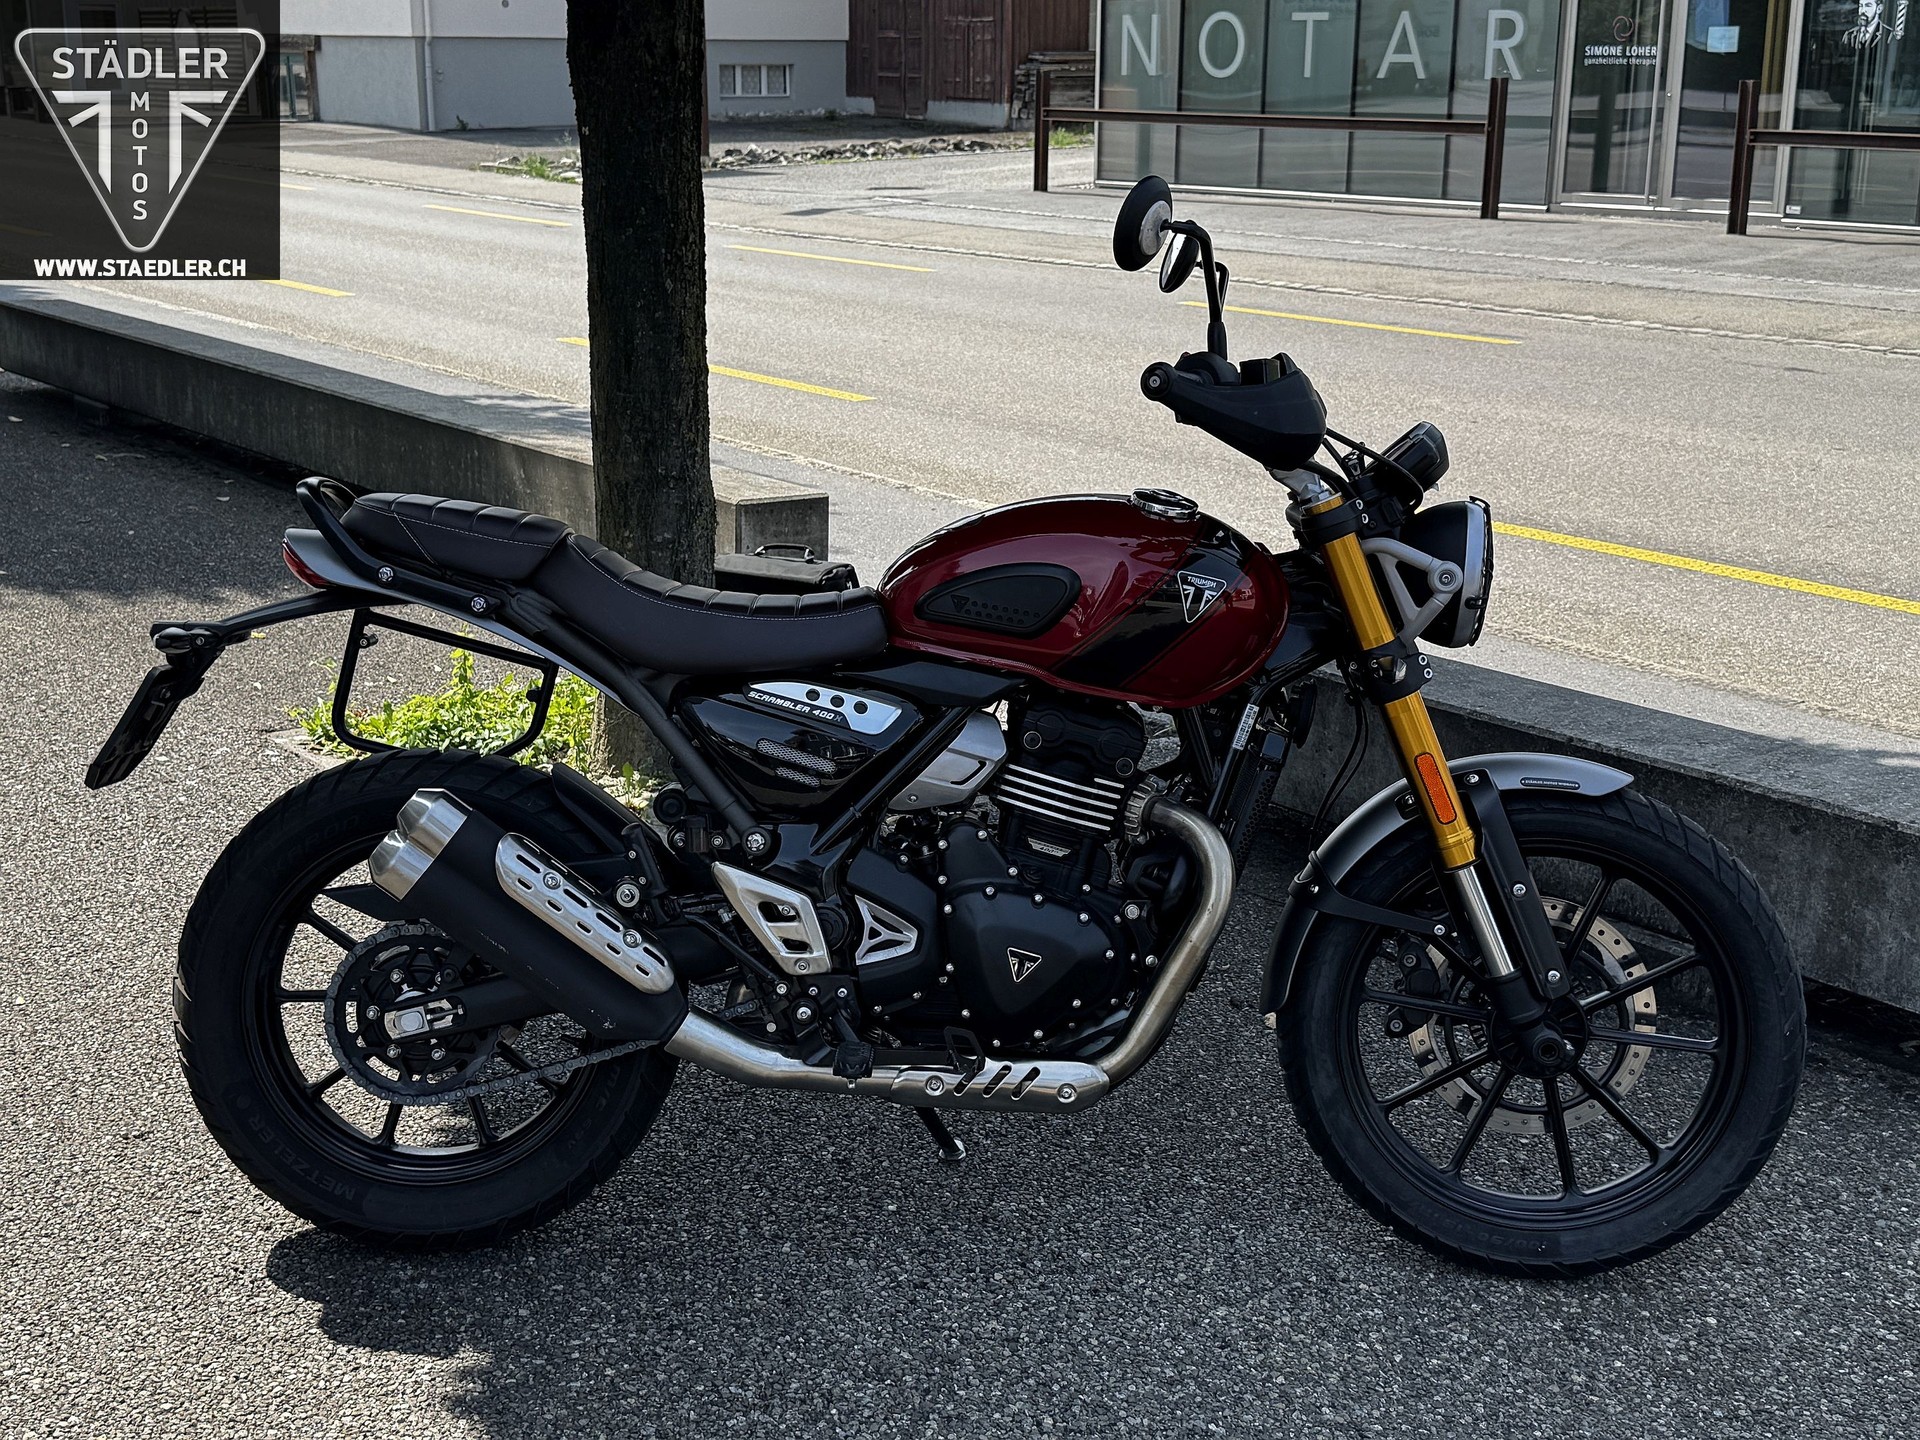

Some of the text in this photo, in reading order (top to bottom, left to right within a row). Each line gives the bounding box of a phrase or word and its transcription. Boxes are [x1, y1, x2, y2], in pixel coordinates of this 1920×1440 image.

[1121, 10, 1525, 81] NOTAR
[1584, 45, 1657, 56] SIMONE LOHER
[1584, 57, 1627, 66] ganzheitliche
[1187, 576, 1217, 588] TRIUMPH
[747, 690, 811, 713] SCRAMBLER
[812, 709, 834, 720] 400
[248, 1113, 357, 1201] METZELER
